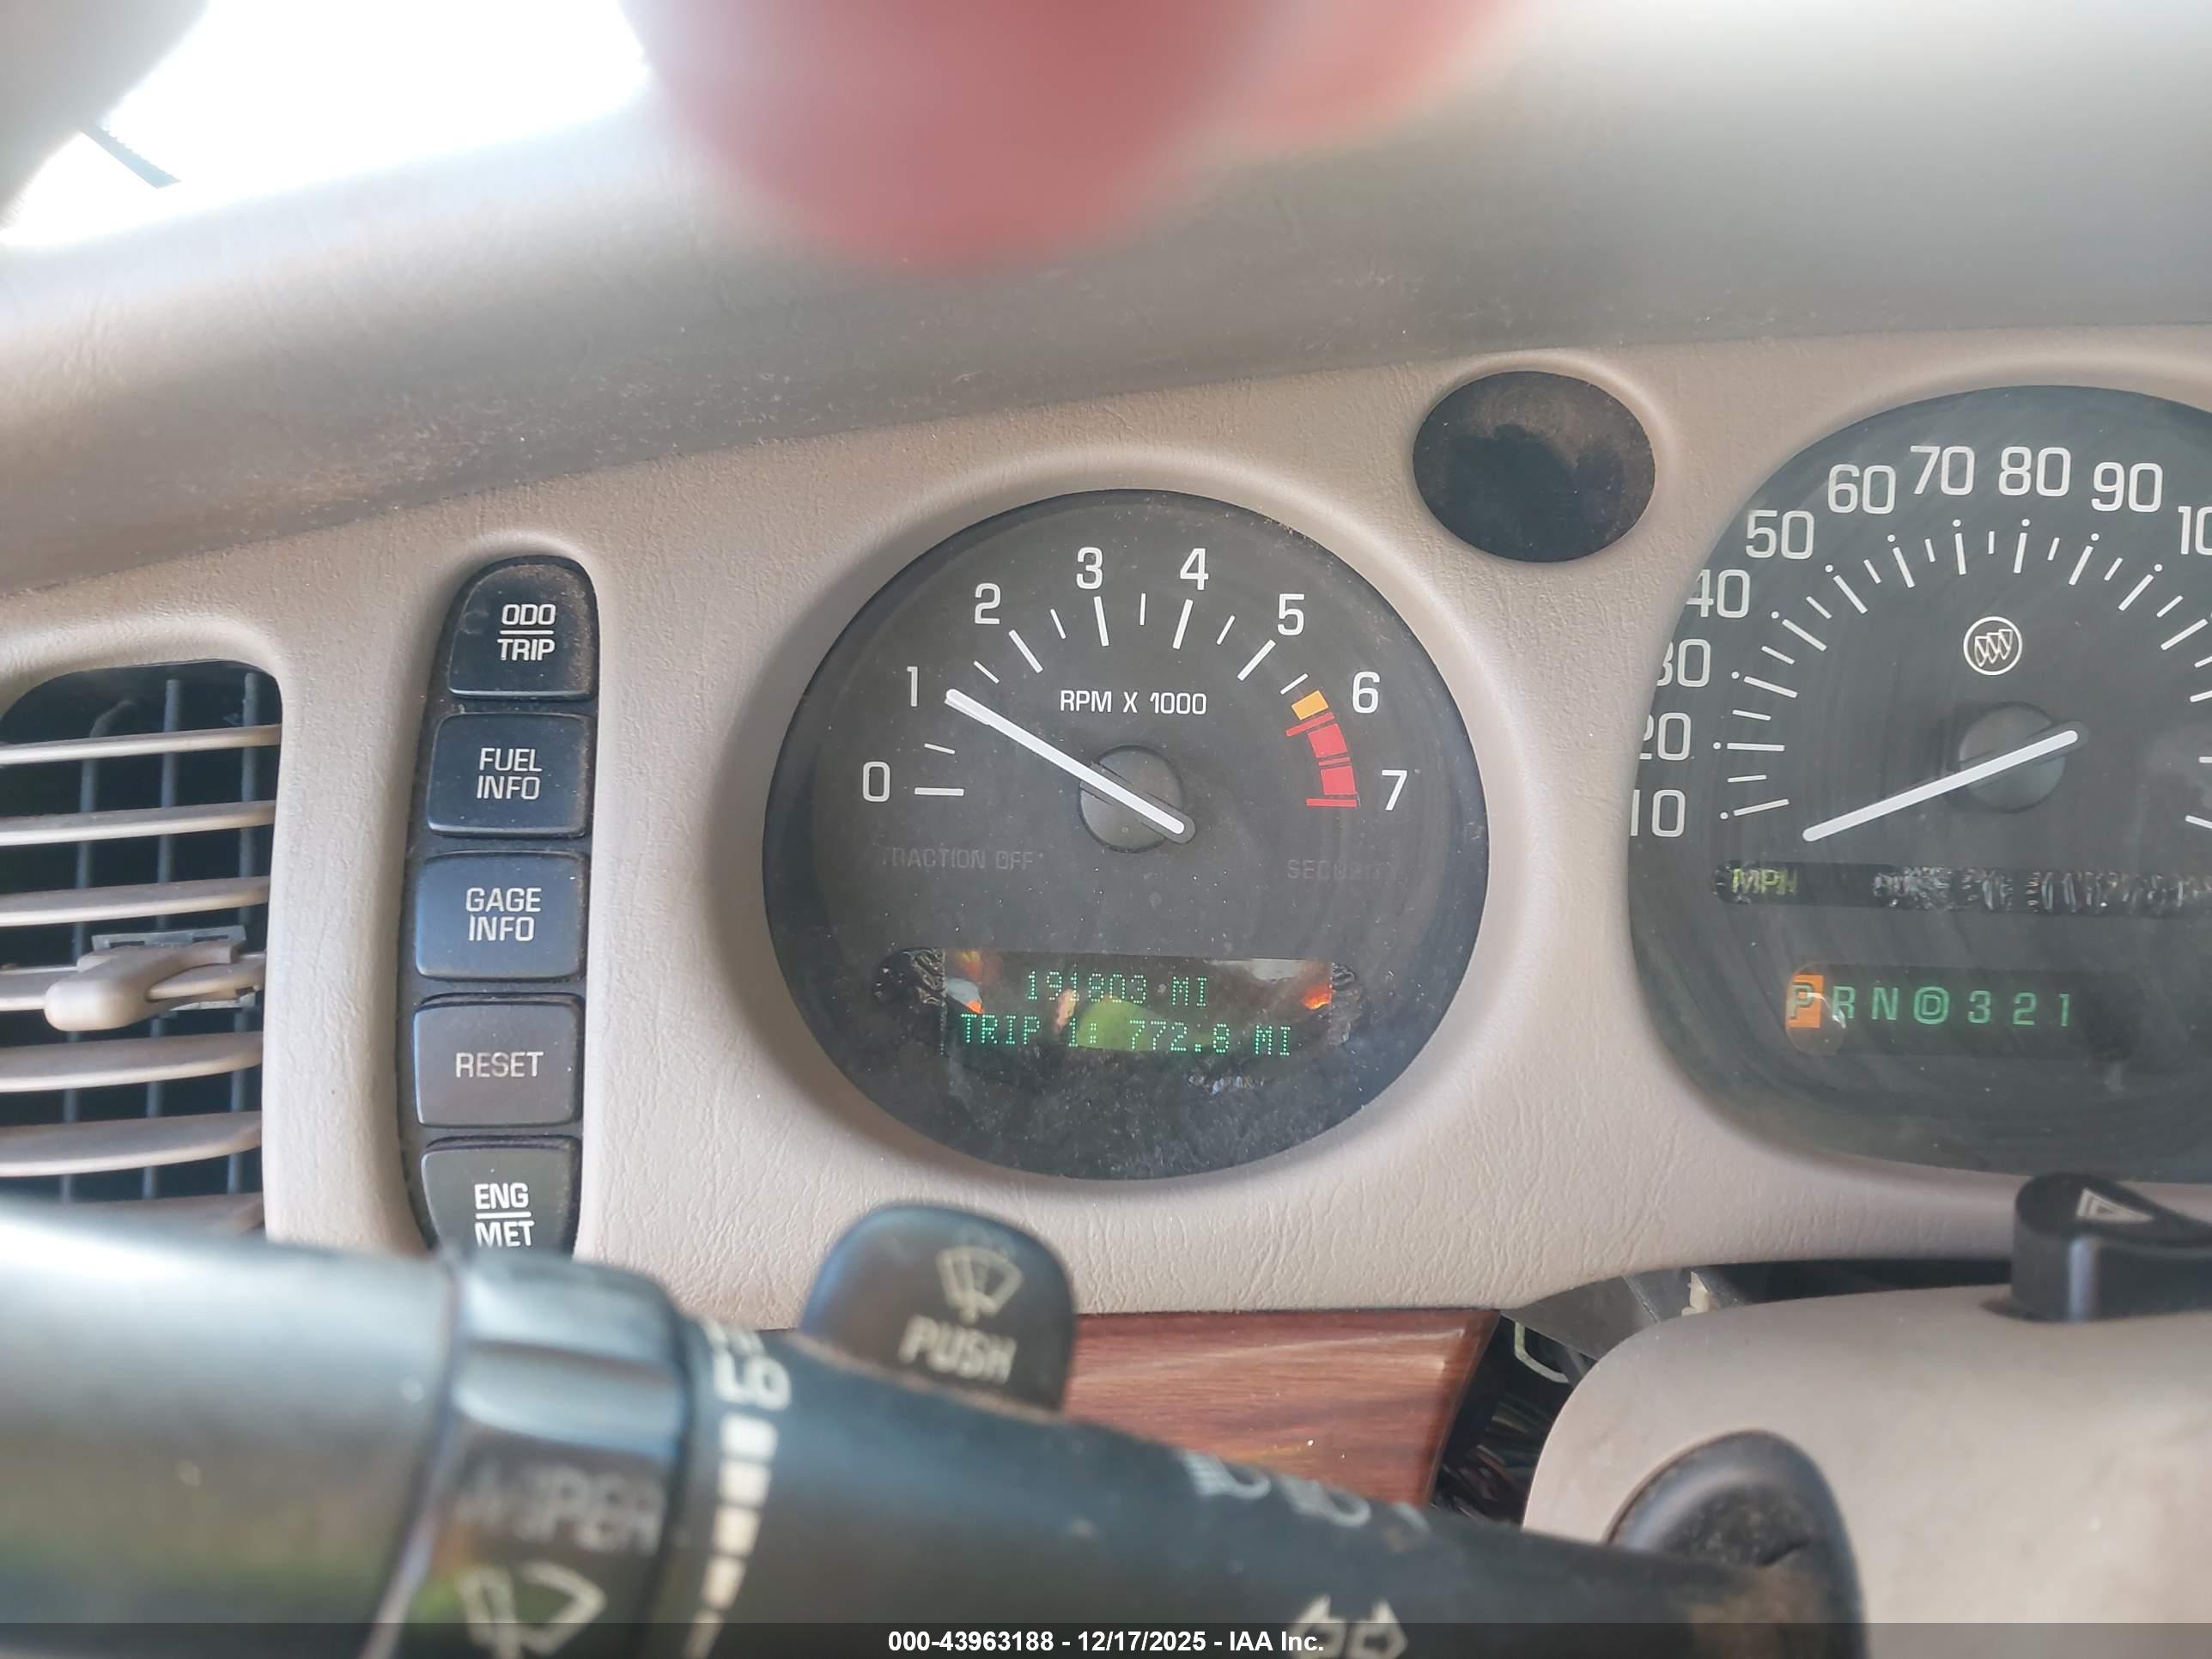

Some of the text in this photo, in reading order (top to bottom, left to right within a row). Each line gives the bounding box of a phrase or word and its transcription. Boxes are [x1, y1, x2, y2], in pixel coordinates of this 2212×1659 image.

[1686, 569, 1750, 618] 40
[1745, 510, 1814, 560] 50
[1827, 464, 1896, 514] 60
[1910, 446, 1975, 495] 70
[1998, 447, 2071, 497] 80
[2092, 461, 2163, 513] 90
[501, 603, 556, 627] ODO
[496, 638, 556, 661] TRIP
[862, 547, 1409, 811] 0 1 2 3 4 5 6 7
[1060, 690, 1207, 714] RPM X 1000
[479, 747, 543, 772] FUEL
[476, 775, 541, 800] INFO
[1285, 859, 1401, 881] SECUR
[1732, 868, 1797, 895] MPH
[465, 887, 543, 914] GAGE
[468, 915, 535, 942] INFO
[1027, 970, 1208, 1007] 191803 MI
[1787, 983, 1815, 1019] P
[1831, 986, 1856, 1019] R
[1871, 988, 1899, 1021] N
[1968, 990, 1992, 1024] 3
[2012, 993, 2038, 1026] 2
[2060, 994, 2070, 1026] 1
[960, 1013, 1291, 1057] TRIP 1: 772.8 MI
[455, 1051, 544, 1079] RESET
[474, 1182, 530, 1209] ENG
[474, 1220, 535, 1248] MET
[897, 1314, 1018, 1385] PUSH
